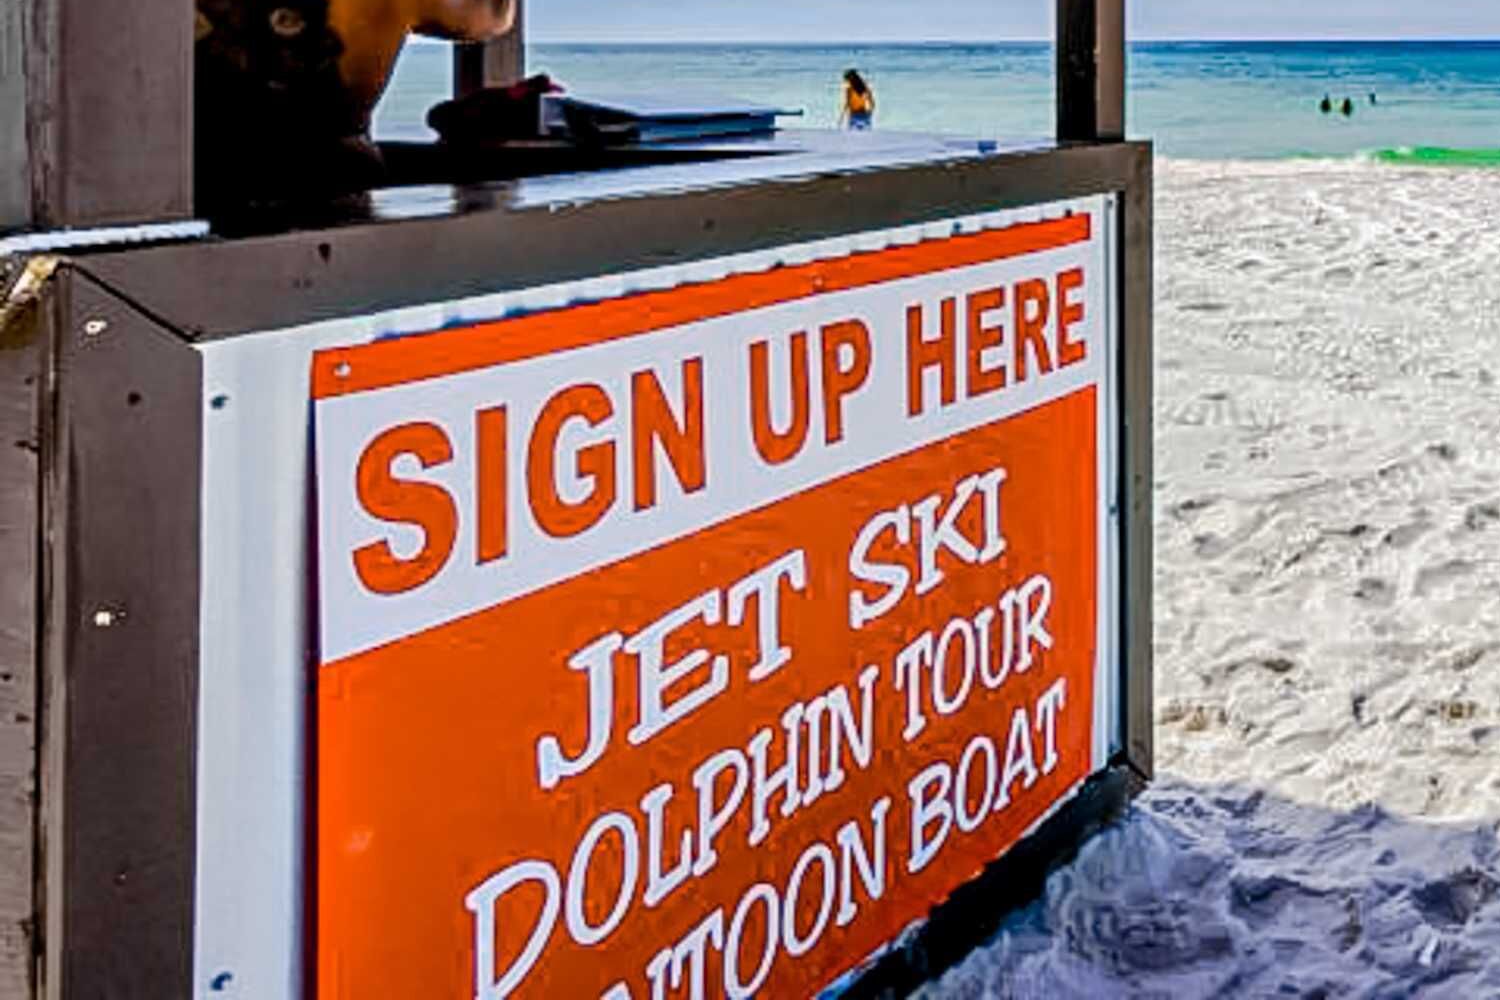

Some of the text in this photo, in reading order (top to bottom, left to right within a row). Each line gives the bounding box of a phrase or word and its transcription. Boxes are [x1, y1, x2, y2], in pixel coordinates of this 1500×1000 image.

[351, 266, 1088, 596] SIGN UP HERE
[464, 573, 1054, 1000] DOLPHIN TOUR
[536, 467, 1007, 790] JET SKI
[904, 679, 1069, 875] BOAT
